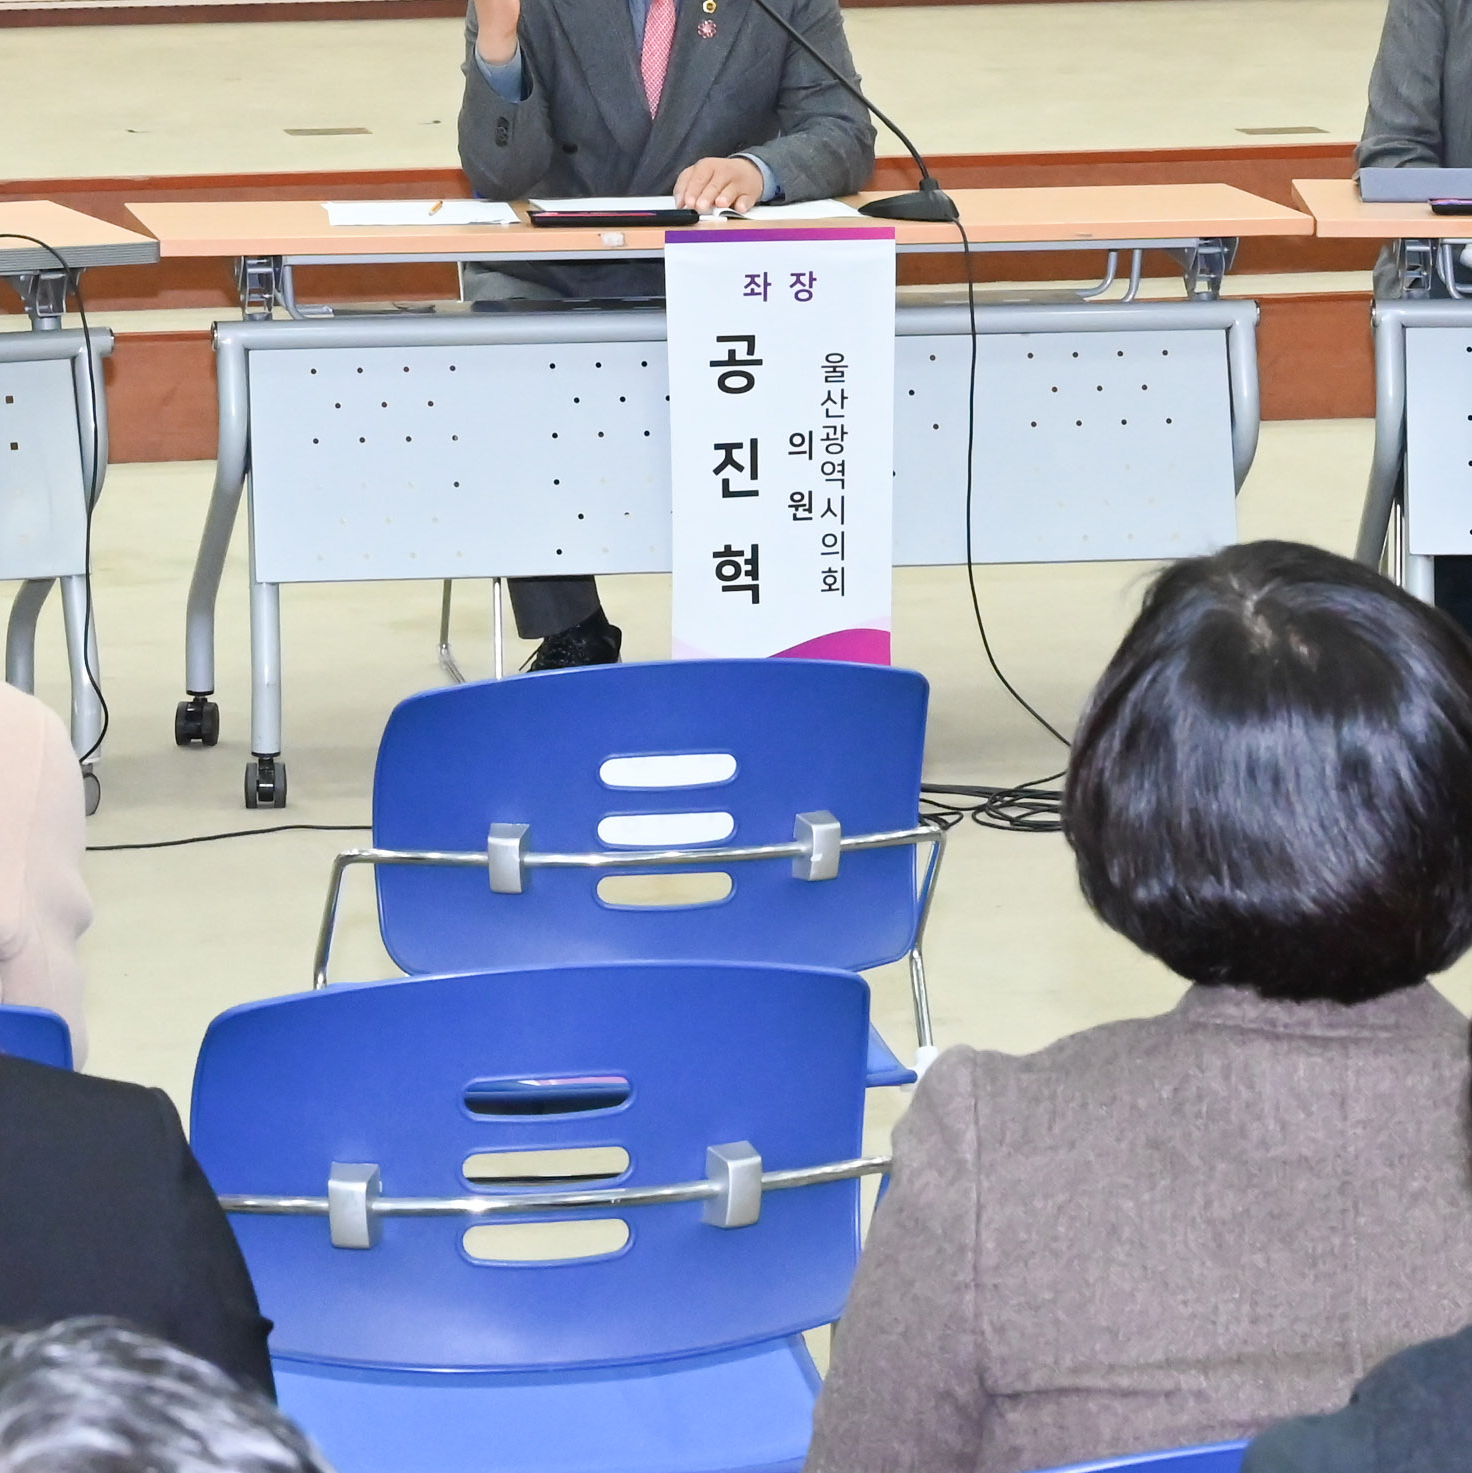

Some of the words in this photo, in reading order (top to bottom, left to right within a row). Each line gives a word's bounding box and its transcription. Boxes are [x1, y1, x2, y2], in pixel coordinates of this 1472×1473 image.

[710, 335, 763, 604] 공진혁
[788, 431, 813, 521] 의원
[820, 353, 848, 596] 울산광역시의회
